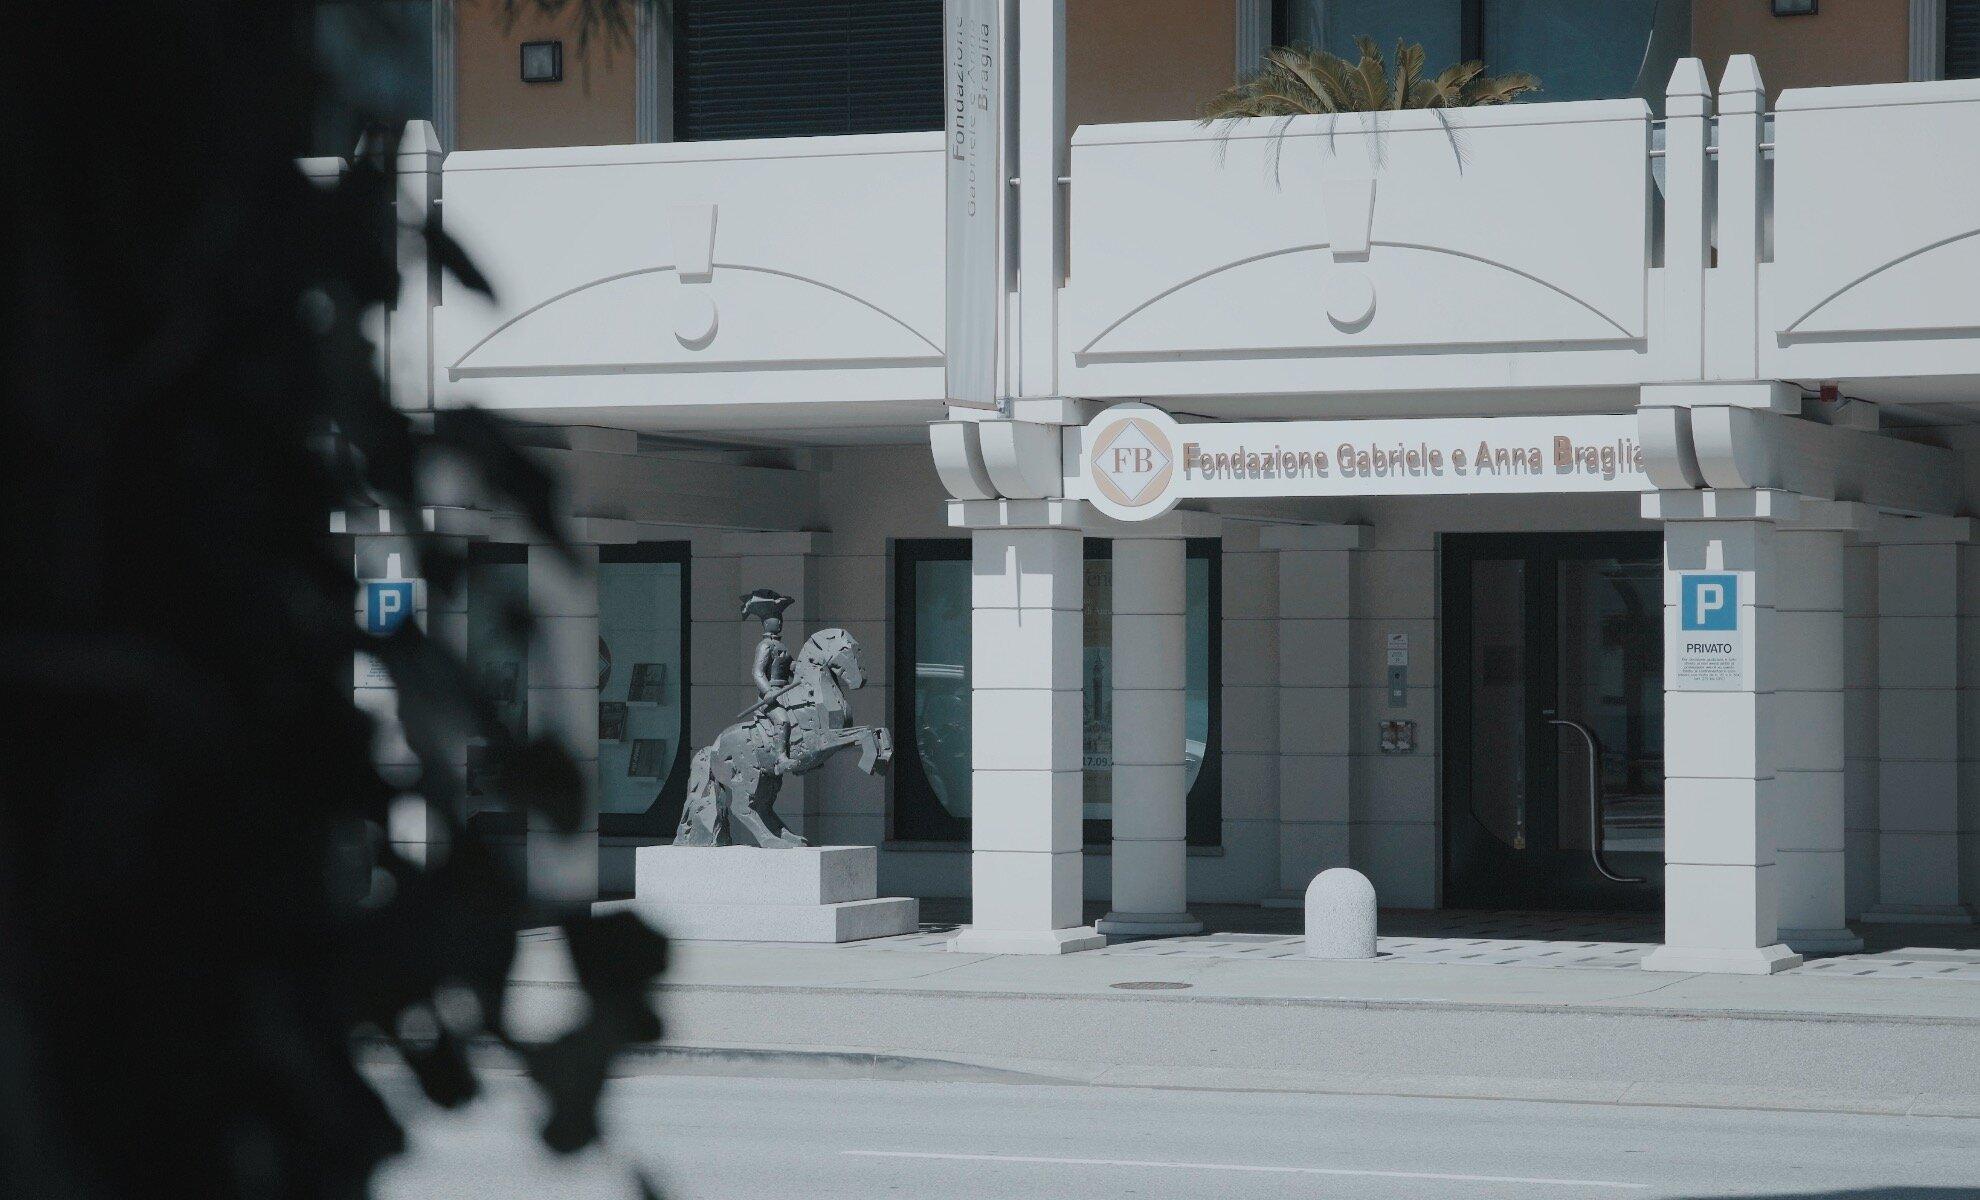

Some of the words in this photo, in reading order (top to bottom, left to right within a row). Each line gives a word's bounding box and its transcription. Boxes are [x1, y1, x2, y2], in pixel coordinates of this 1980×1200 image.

[977, 23, 992, 111] Braglia
[952, 16, 965, 161] Fondazione
[1111, 447, 1153, 474] FB
[1183, 443, 1328, 476] Fondazione
[1337, 442, 1443, 473] Gabriele
[1452, 448, 1466, 474] e
[1475, 441, 1542, 472] Anna
[379, 590, 401, 626] P
[1697, 584, 1724, 625] P
[1686, 643, 1732, 654] PRIVATO
